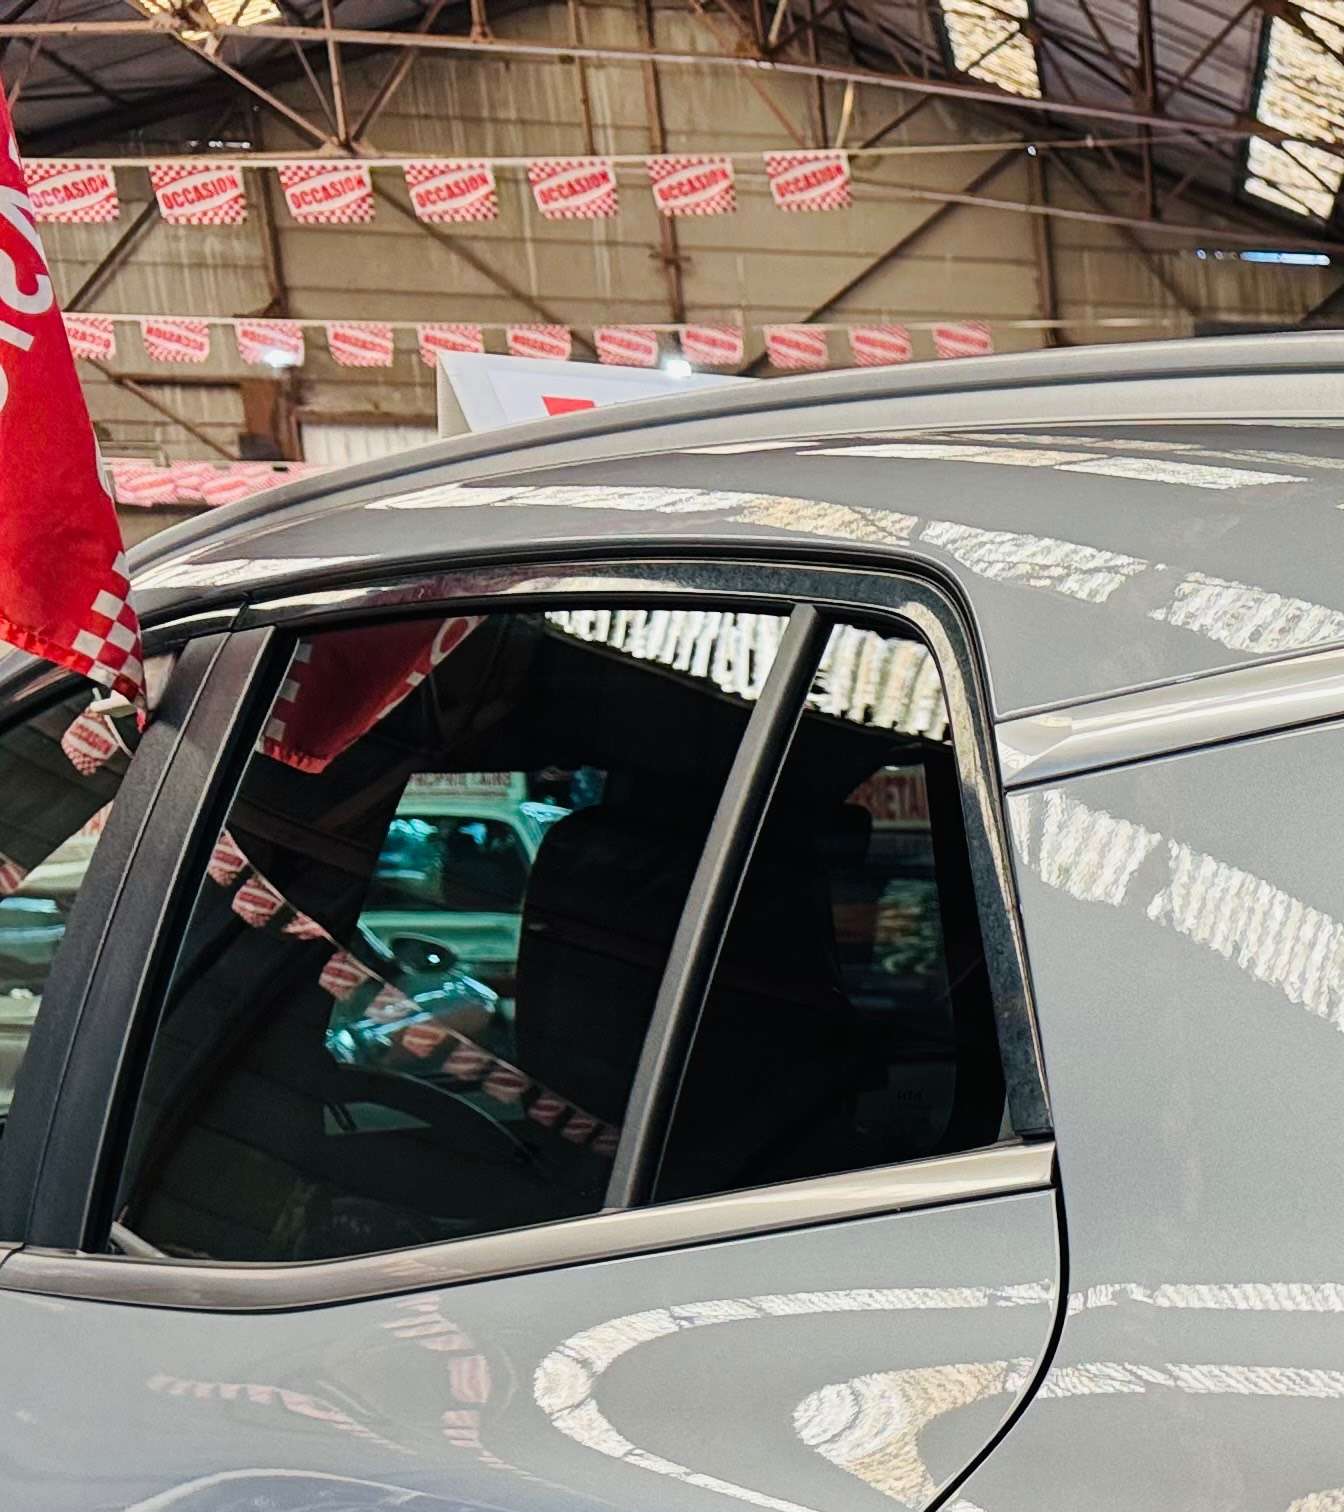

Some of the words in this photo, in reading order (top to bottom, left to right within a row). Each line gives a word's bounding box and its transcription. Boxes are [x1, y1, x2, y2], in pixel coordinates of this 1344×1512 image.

[160, 174, 239, 210] OCCASION
[289, 175, 367, 209] OCCASION
[415, 171, 490, 207] OCCASION
